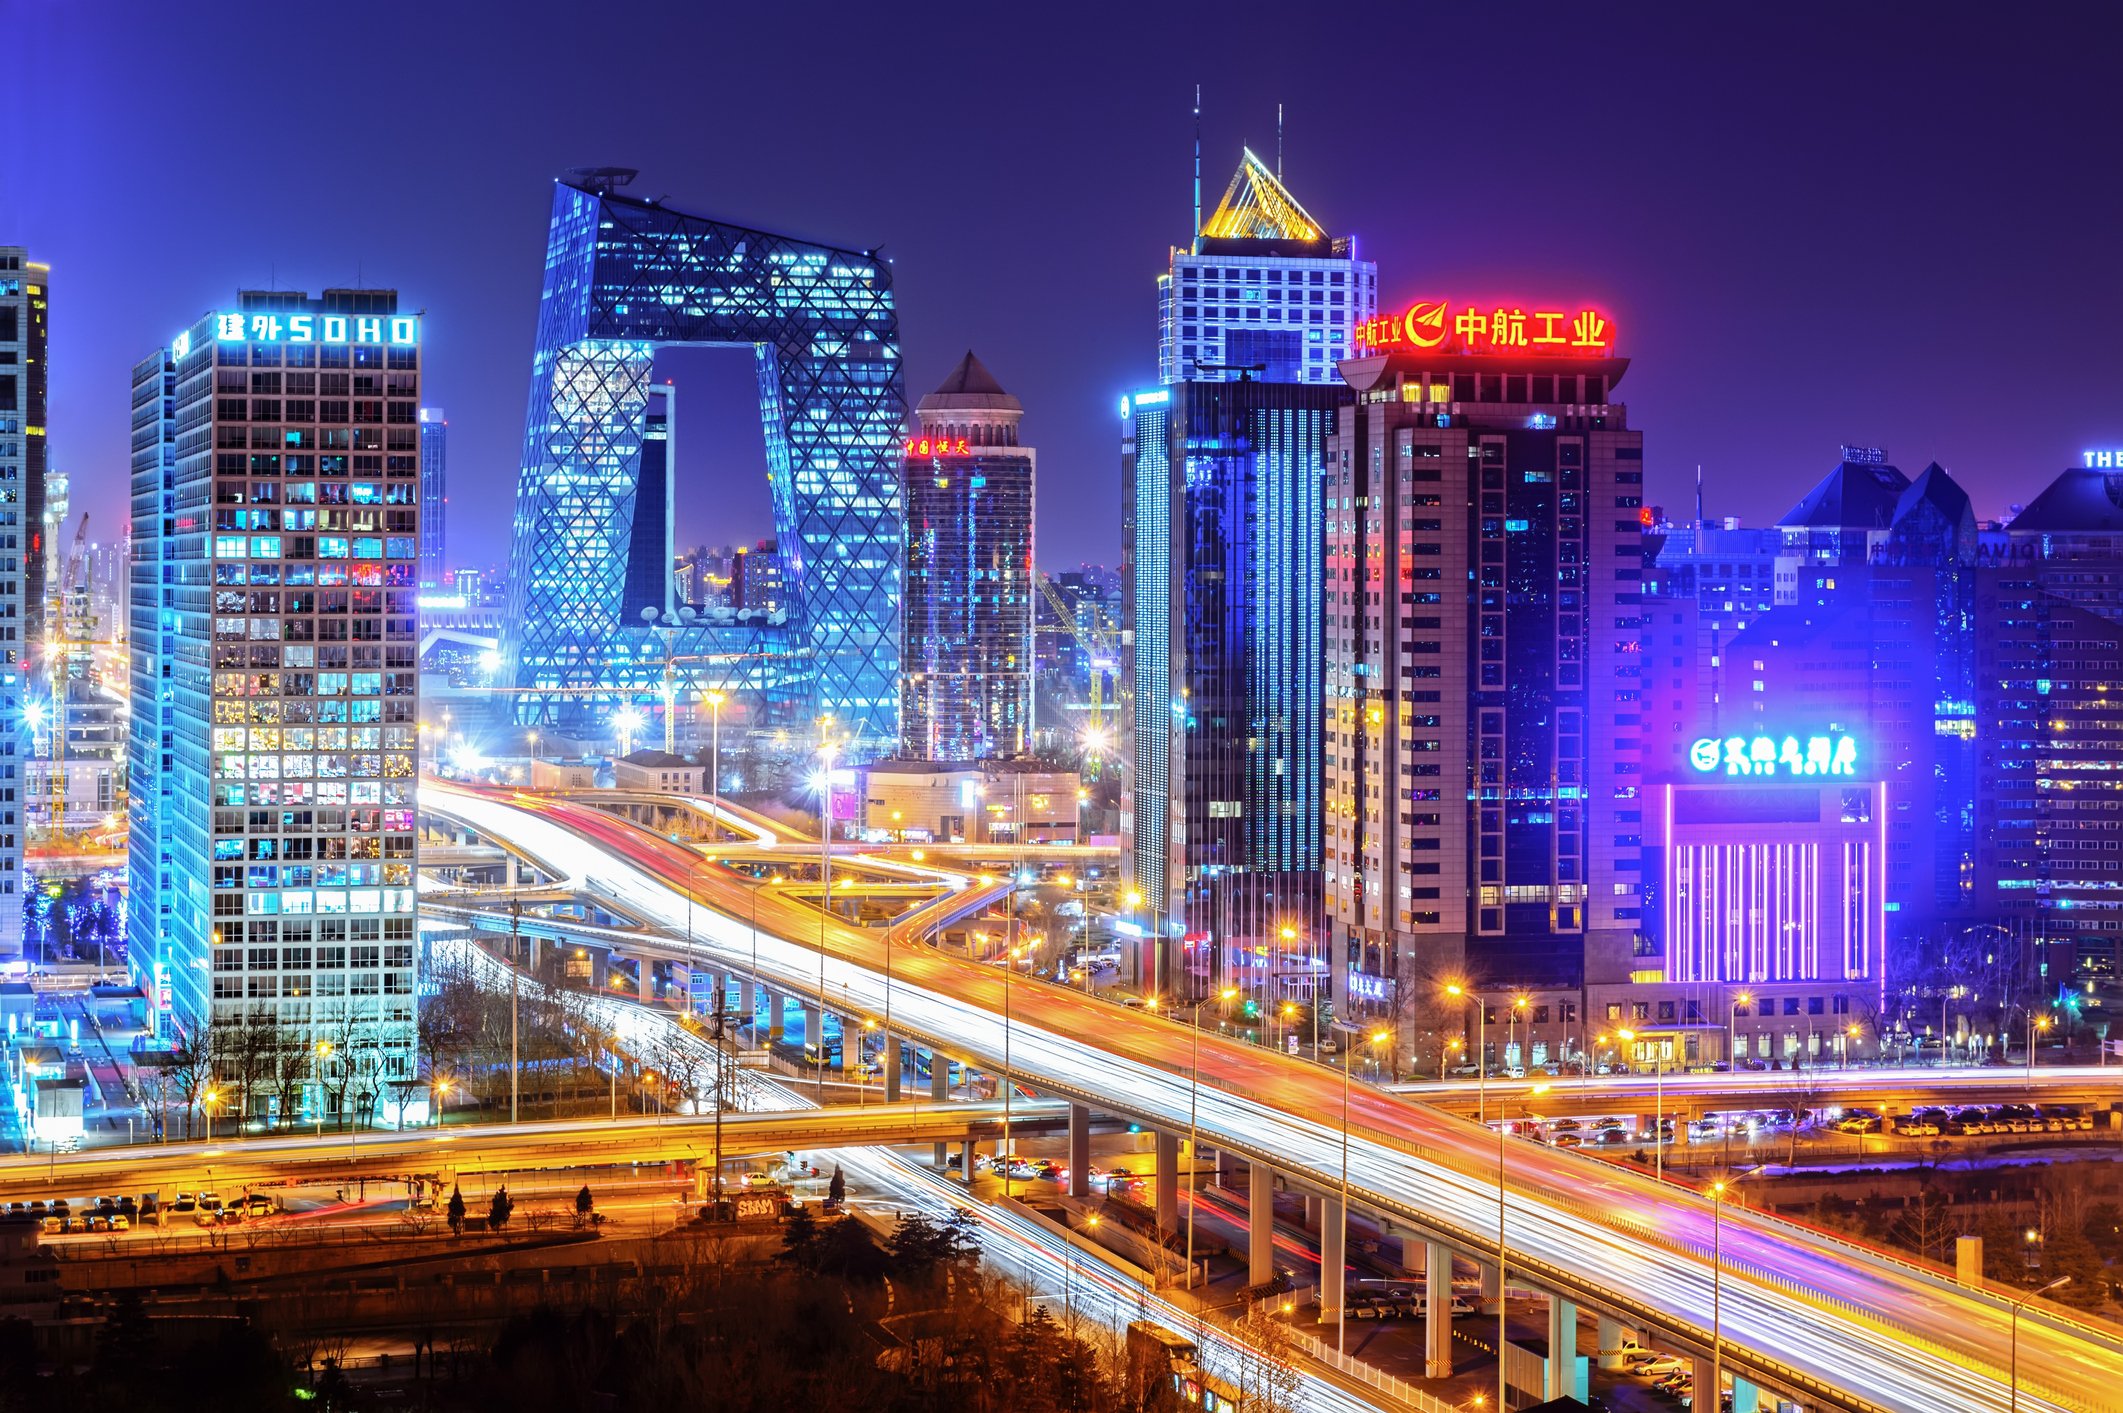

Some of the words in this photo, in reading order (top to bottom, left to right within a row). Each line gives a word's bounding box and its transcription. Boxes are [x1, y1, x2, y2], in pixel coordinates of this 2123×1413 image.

[217, 313, 415, 344] 建外SOHO
[1355, 315, 1402, 348] 中航工业
[1455, 307, 1606, 347] 中航工业
[907, 439, 969, 456] 中国恒天
[2083, 451, 2123, 468] THE
